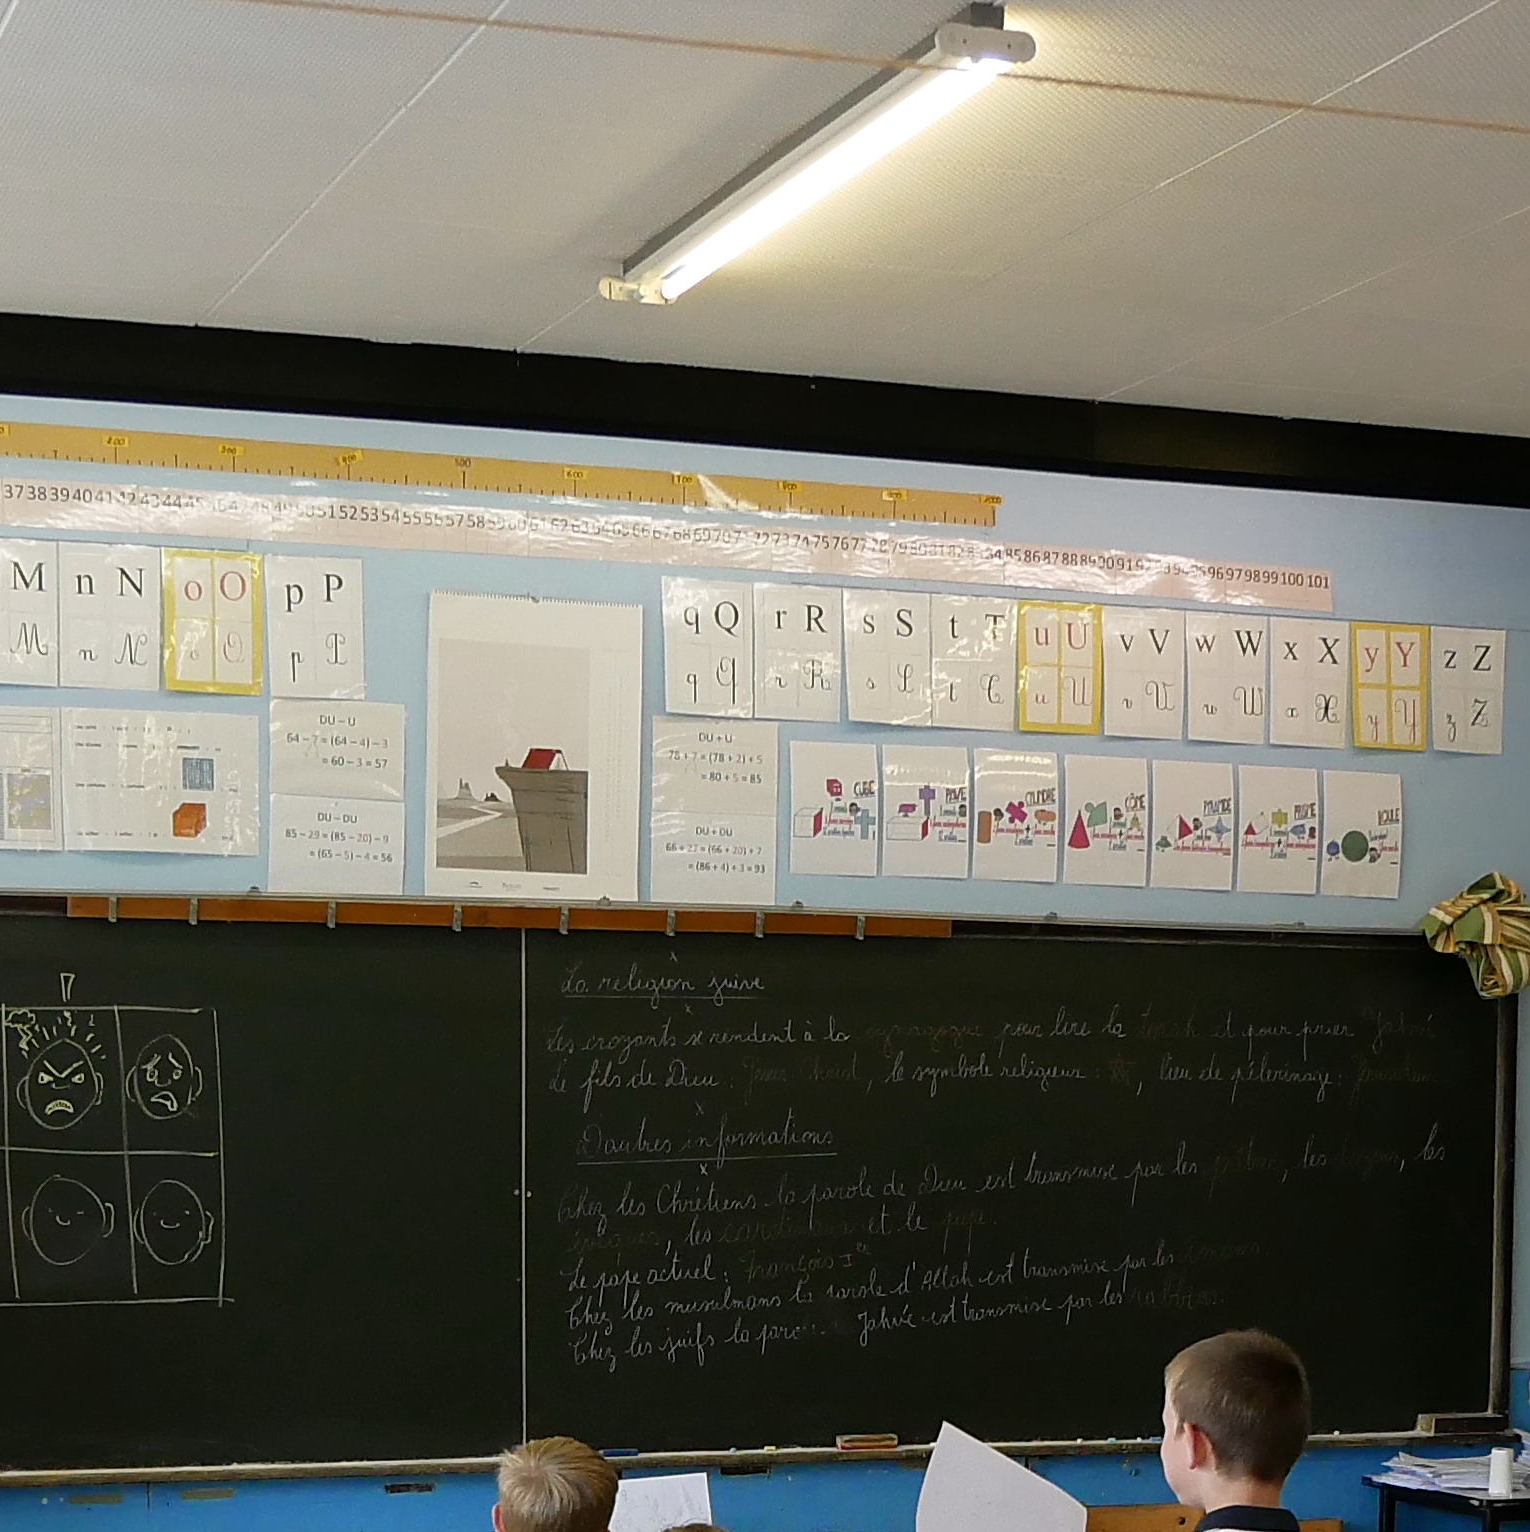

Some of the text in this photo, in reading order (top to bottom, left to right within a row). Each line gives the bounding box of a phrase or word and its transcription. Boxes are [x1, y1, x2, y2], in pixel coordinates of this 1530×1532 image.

[28, 486, 47, 500] 38
[1281, 572, 1303, 586] 100
[1309, 575, 1328, 588] 101
[597, 963, 695, 1010] religion
[708, 974, 765, 1007] juive
[581, 1017, 677, 1065] croyants
[709, 1020, 796, 1044] rendent
[1050, 1005, 1091, 1038] lire
[1101, 1003, 1128, 1038] la
[1296, 1020, 1356, 1062] prier
[579, 1058, 622, 1114] fils
[665, 1058, 721, 1089] Dieu
[911, 1052, 994, 1098] symbole
[656, 1178, 758, 1215] Chrétiens
[803, 1166, 875, 1233] parole
[1024, 1150, 1118, 1185] transmise
[593, 1268, 642, 1311] pape
[646, 1250, 716, 1284] actuel
[664, 1285, 782, 1316] musulmans
[658, 1321, 716, 1368] juifs
